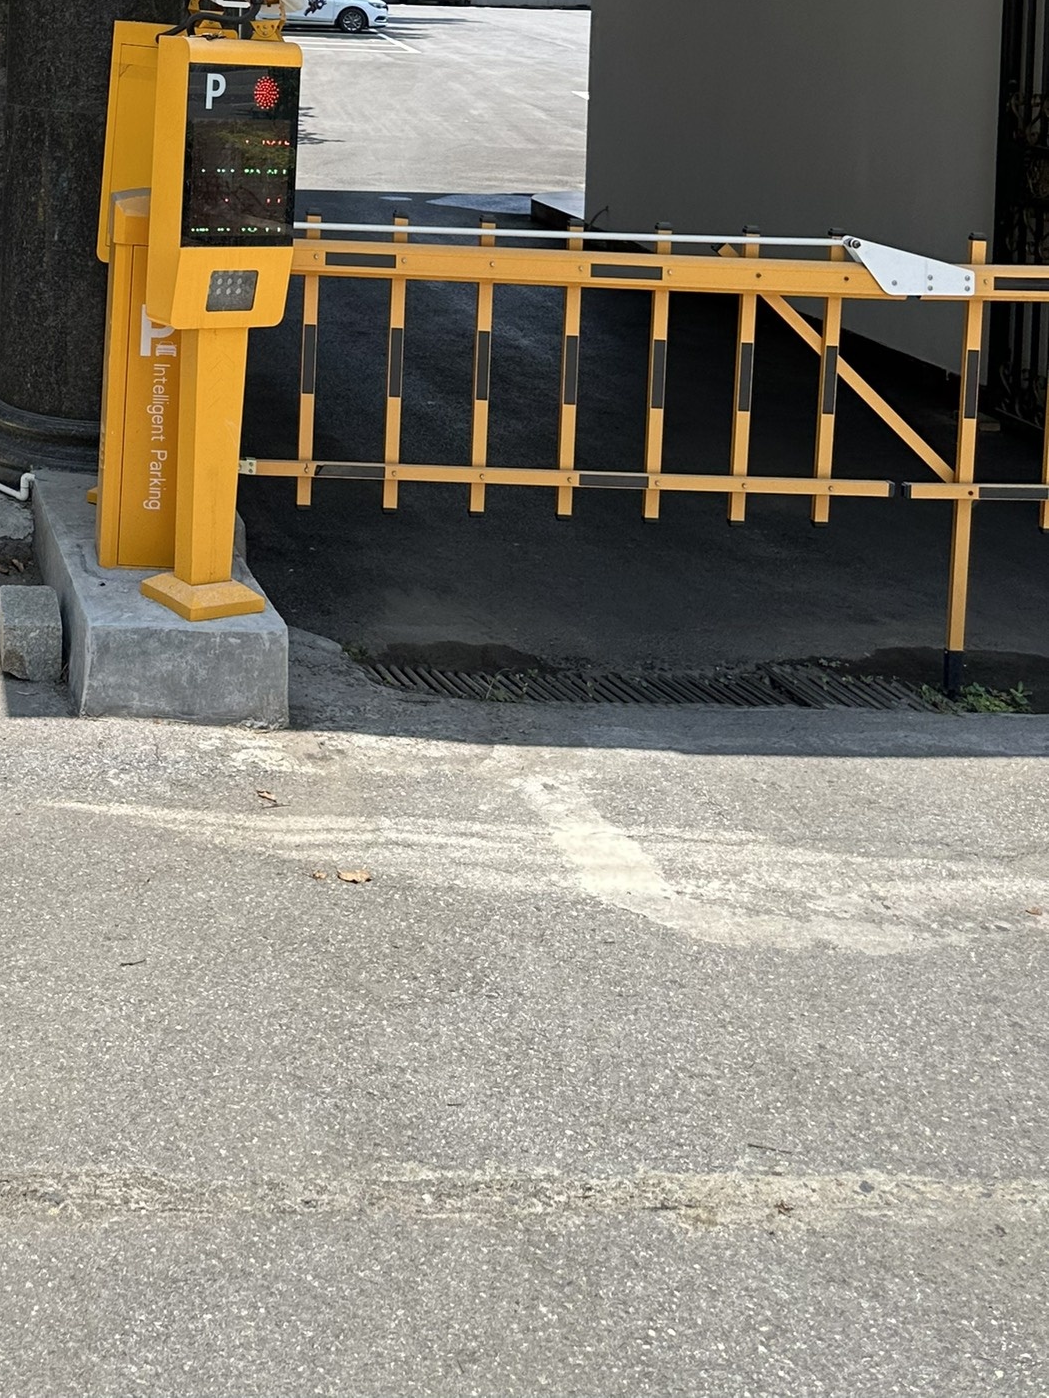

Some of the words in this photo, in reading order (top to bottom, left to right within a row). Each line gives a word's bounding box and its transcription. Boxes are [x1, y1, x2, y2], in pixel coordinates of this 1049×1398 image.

[205, 73, 227, 110] P
[146, 363, 171, 442] Intelligent
[143, 449, 168, 511] Parking
